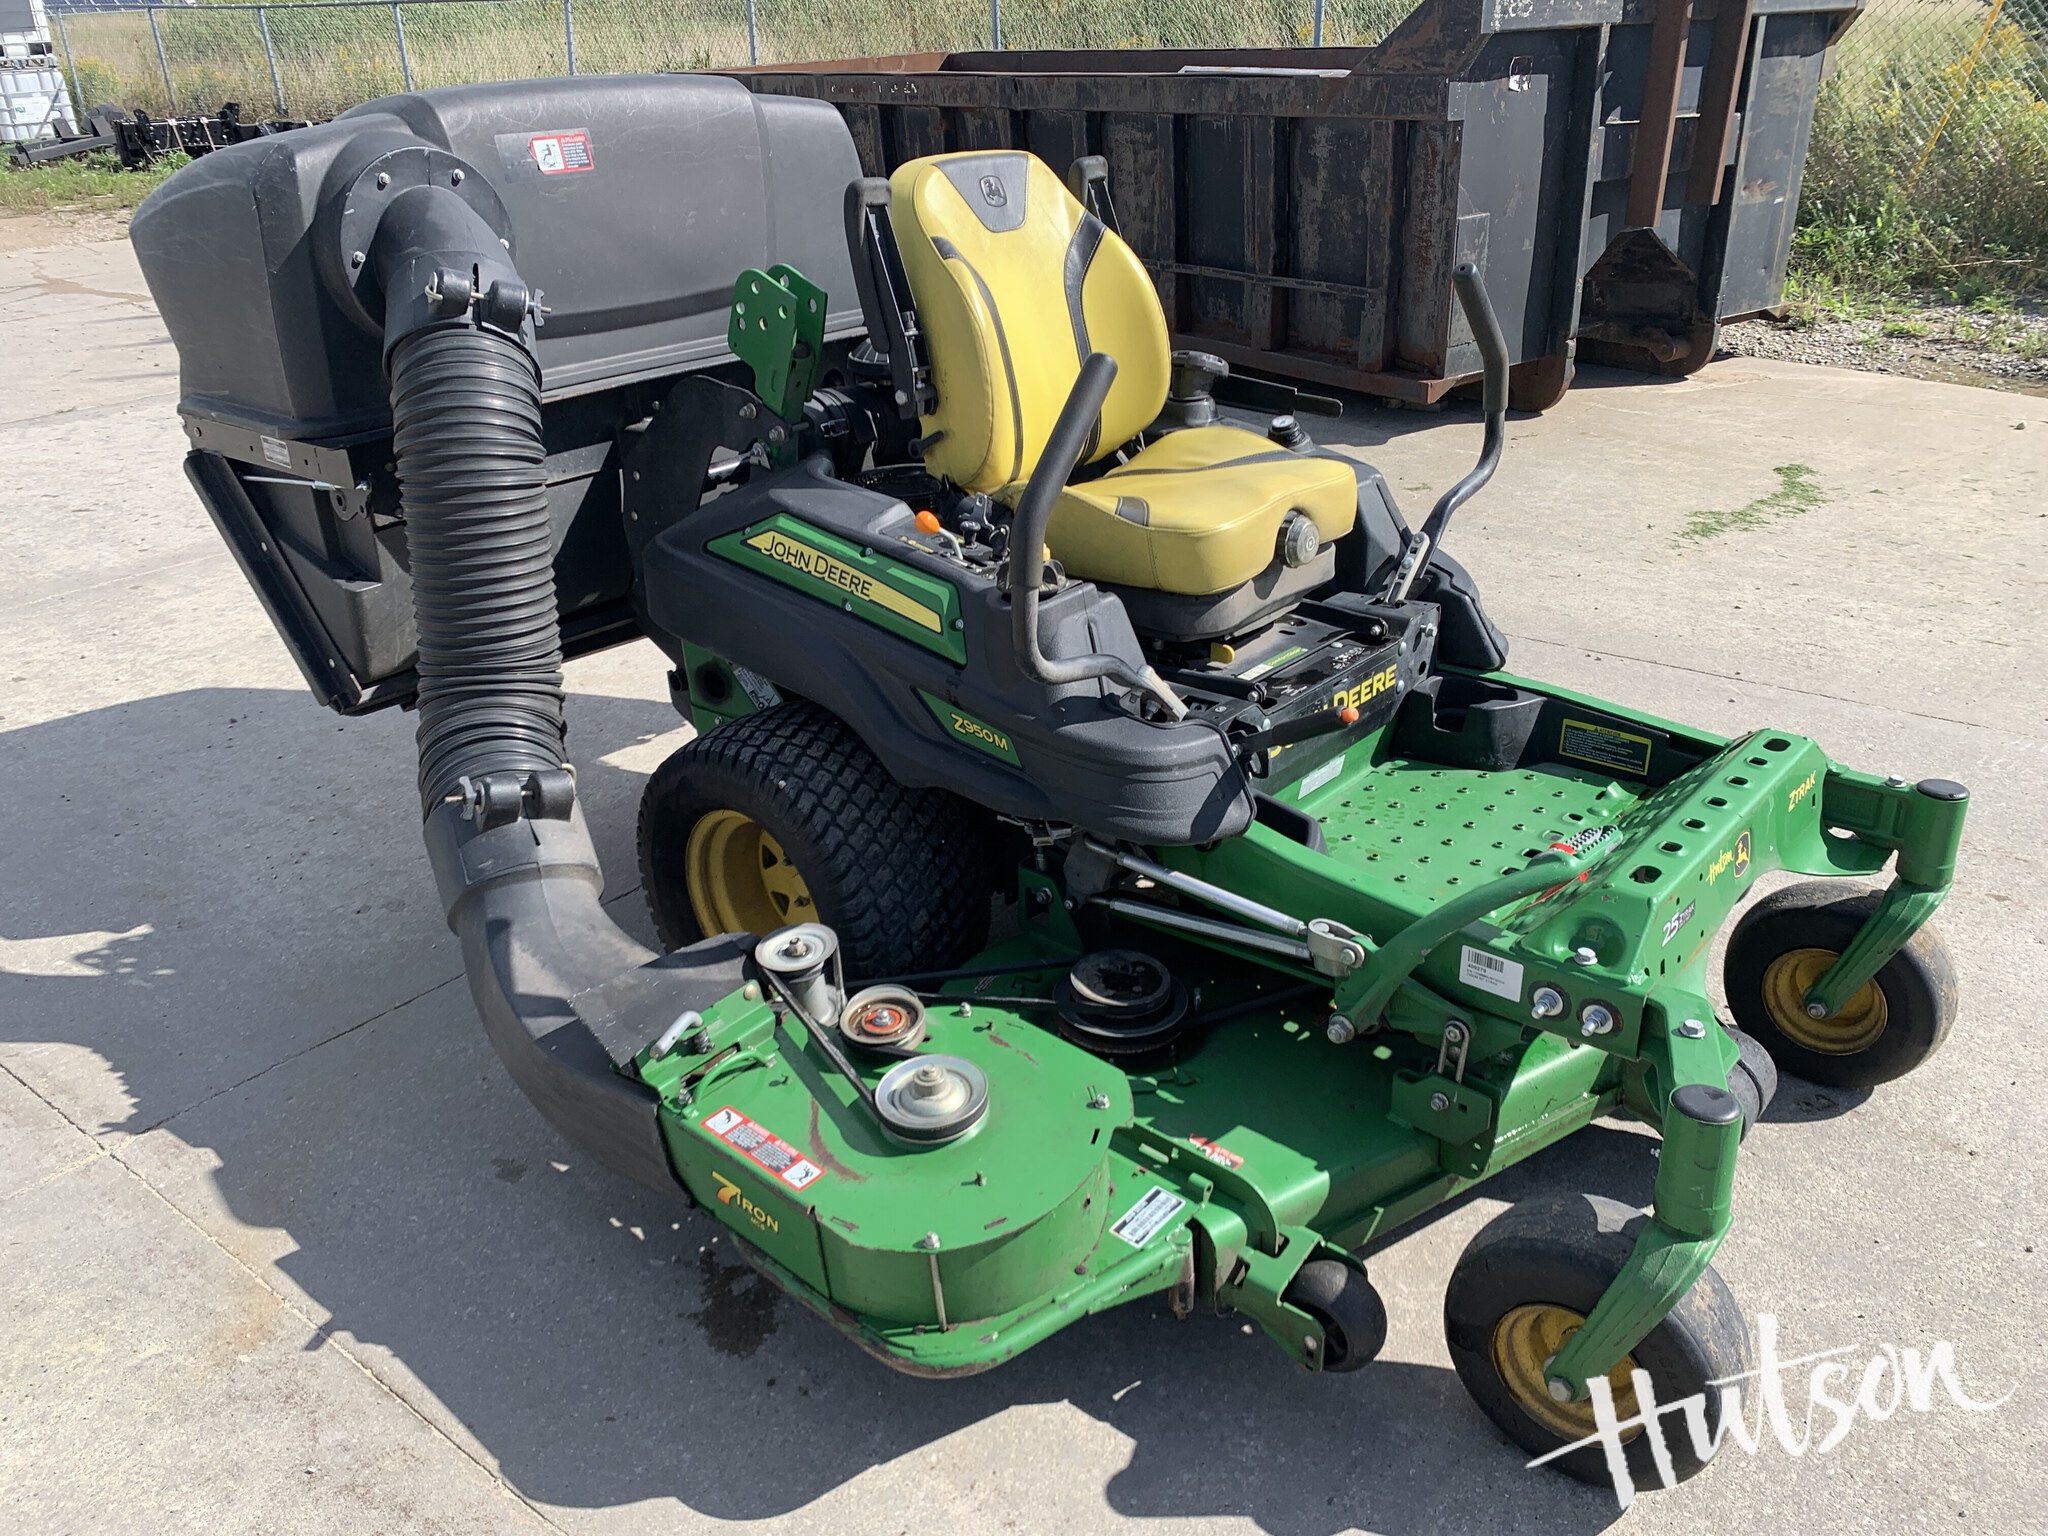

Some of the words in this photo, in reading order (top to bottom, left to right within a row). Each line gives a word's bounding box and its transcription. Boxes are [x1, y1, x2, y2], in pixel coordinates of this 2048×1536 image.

[763, 535, 811, 570] JOHN
[814, 555, 873, 598] DEERE
[1333, 663, 1397, 710] DEERE
[950, 712, 1009, 752] Z950M
[1787, 769, 1817, 814] ZTRAK
[1661, 911, 1679, 948] 25
